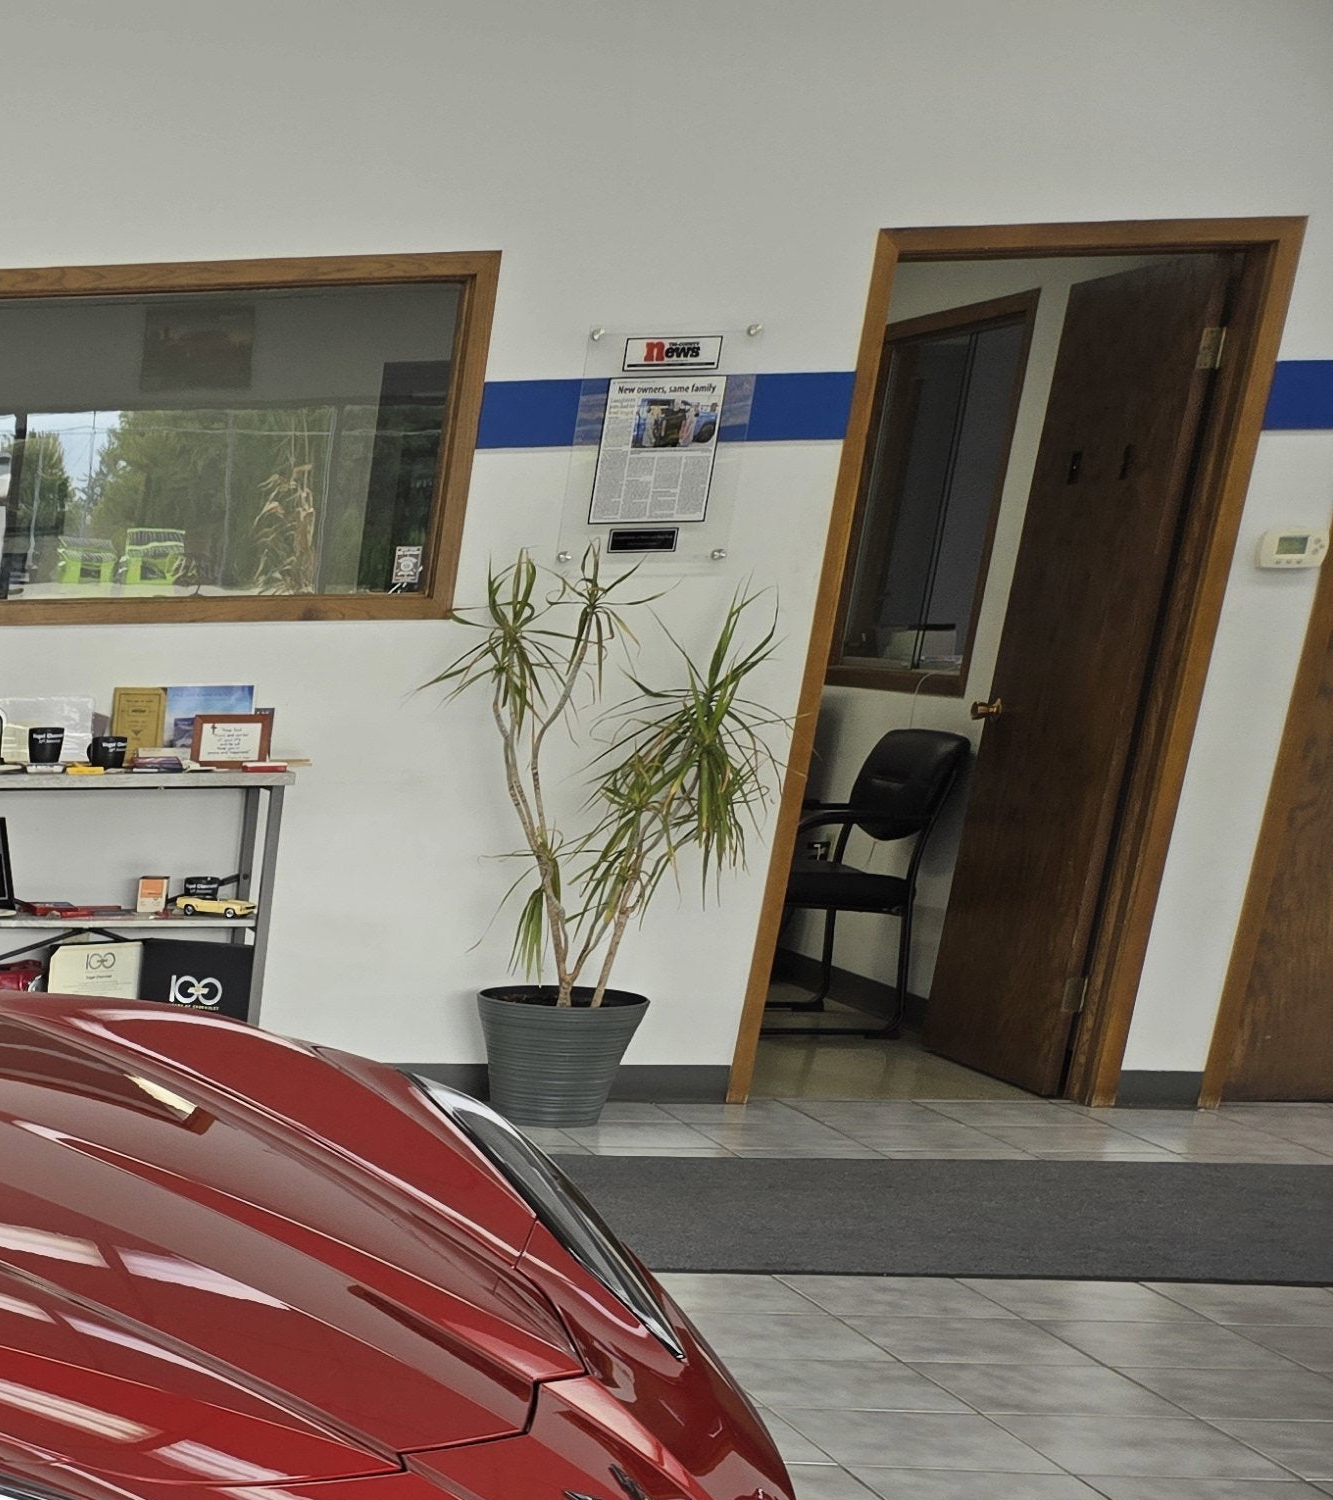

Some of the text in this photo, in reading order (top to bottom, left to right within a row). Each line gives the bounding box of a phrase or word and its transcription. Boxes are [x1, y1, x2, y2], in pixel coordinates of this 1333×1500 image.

[617, 382, 717, 394] New owners, same family
[85, 952, 116, 970] 100
[169, 974, 223, 1006] 100
